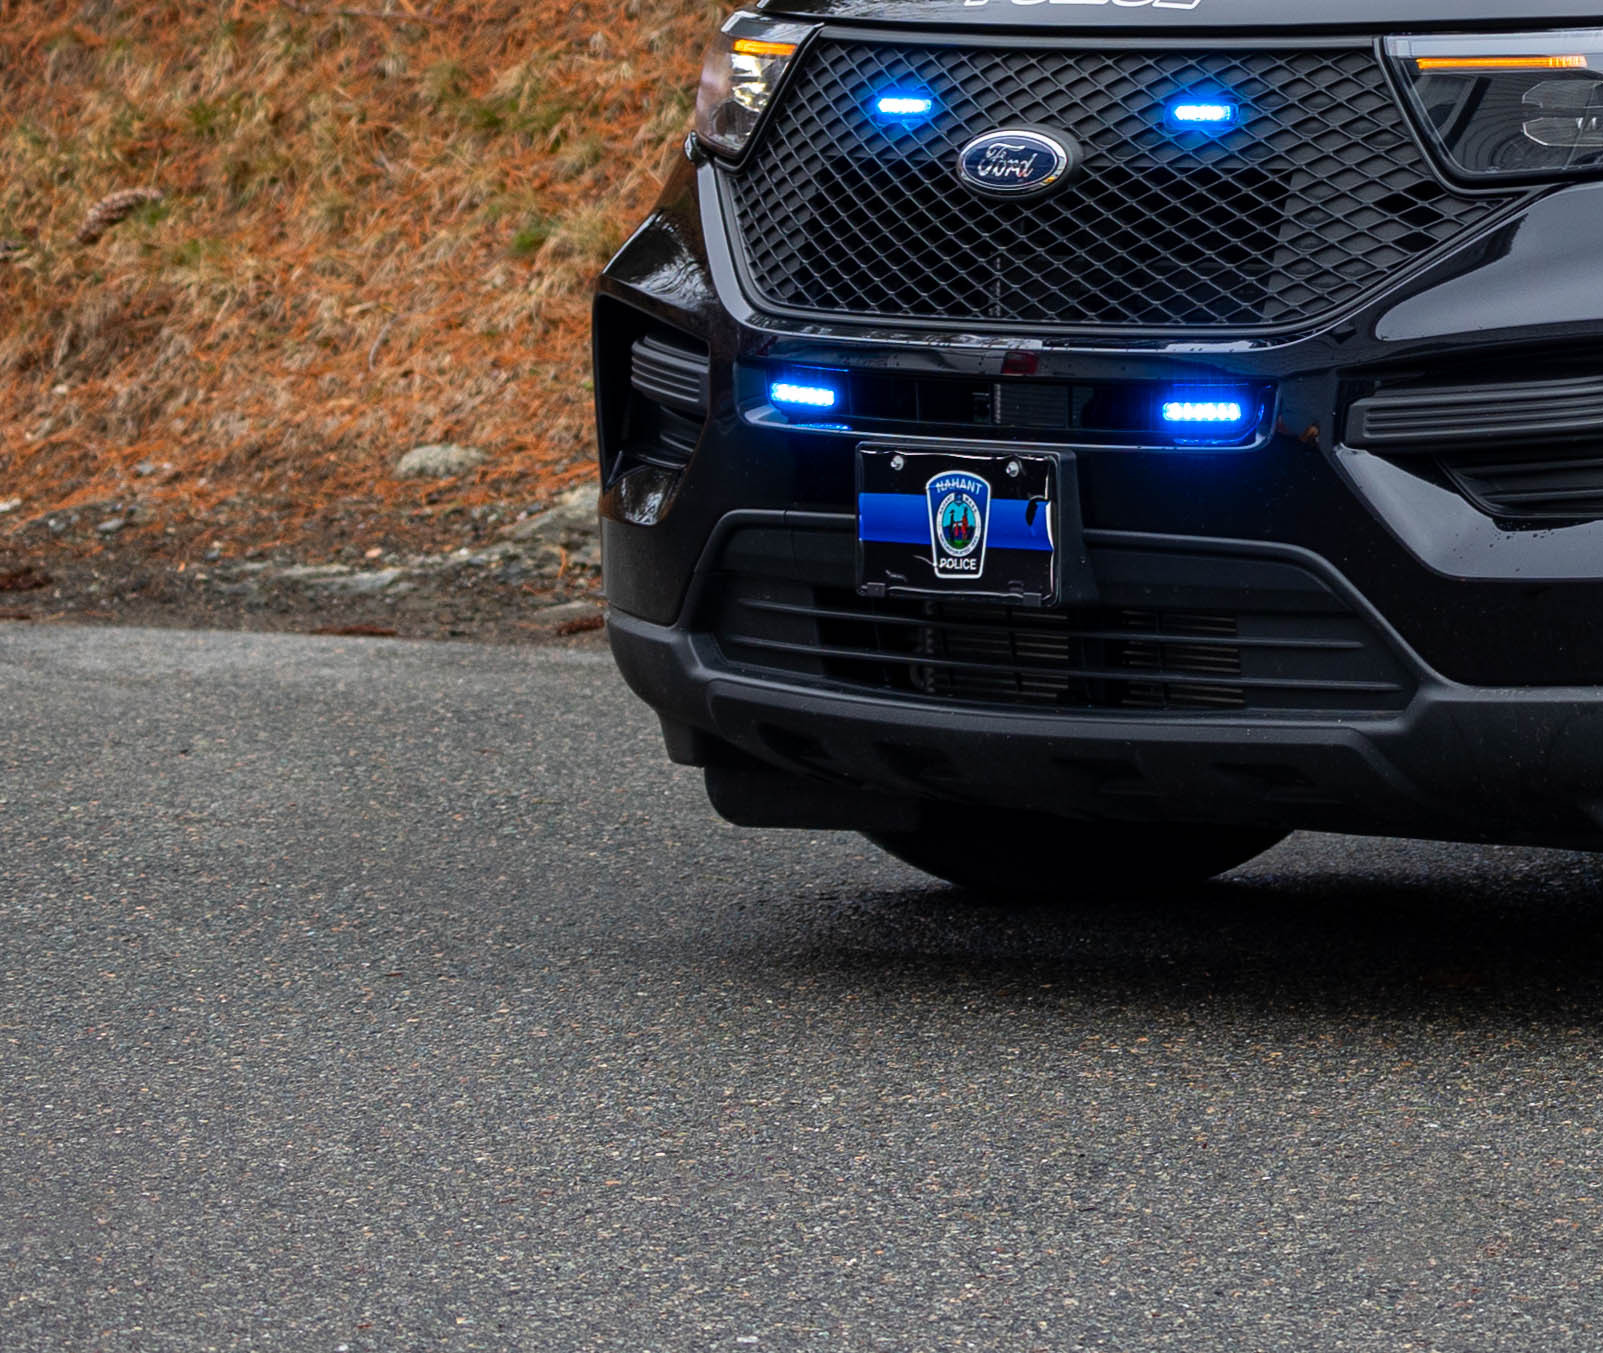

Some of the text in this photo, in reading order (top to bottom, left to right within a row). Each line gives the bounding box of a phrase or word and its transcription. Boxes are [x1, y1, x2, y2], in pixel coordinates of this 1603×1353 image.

[976, 142, 1038, 178] Ford
[935, 477, 982, 494] NAHANT
[939, 557, 977, 570] POLICE
